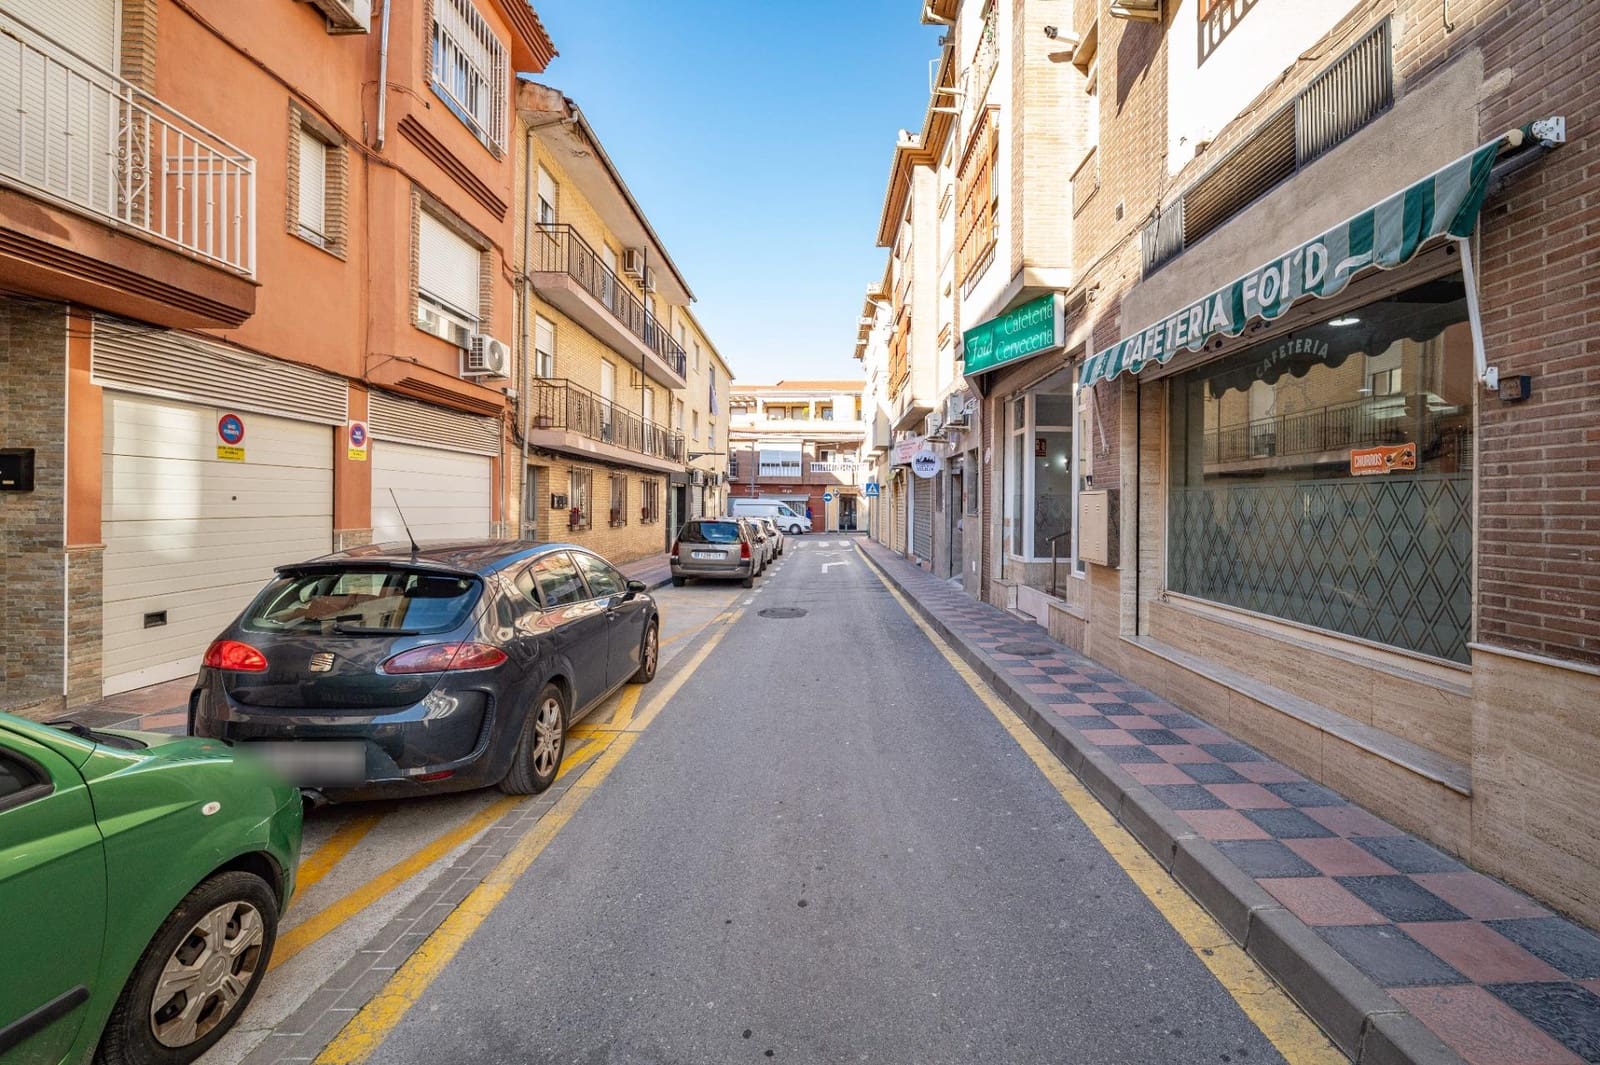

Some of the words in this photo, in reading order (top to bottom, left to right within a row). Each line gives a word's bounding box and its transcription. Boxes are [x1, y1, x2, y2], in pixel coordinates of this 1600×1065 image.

[1121, 294, 1229, 365] CAFETERIA
[1256, 338, 1329, 378] CAFETERIA
[1354, 452, 1382, 467] CHURROS
